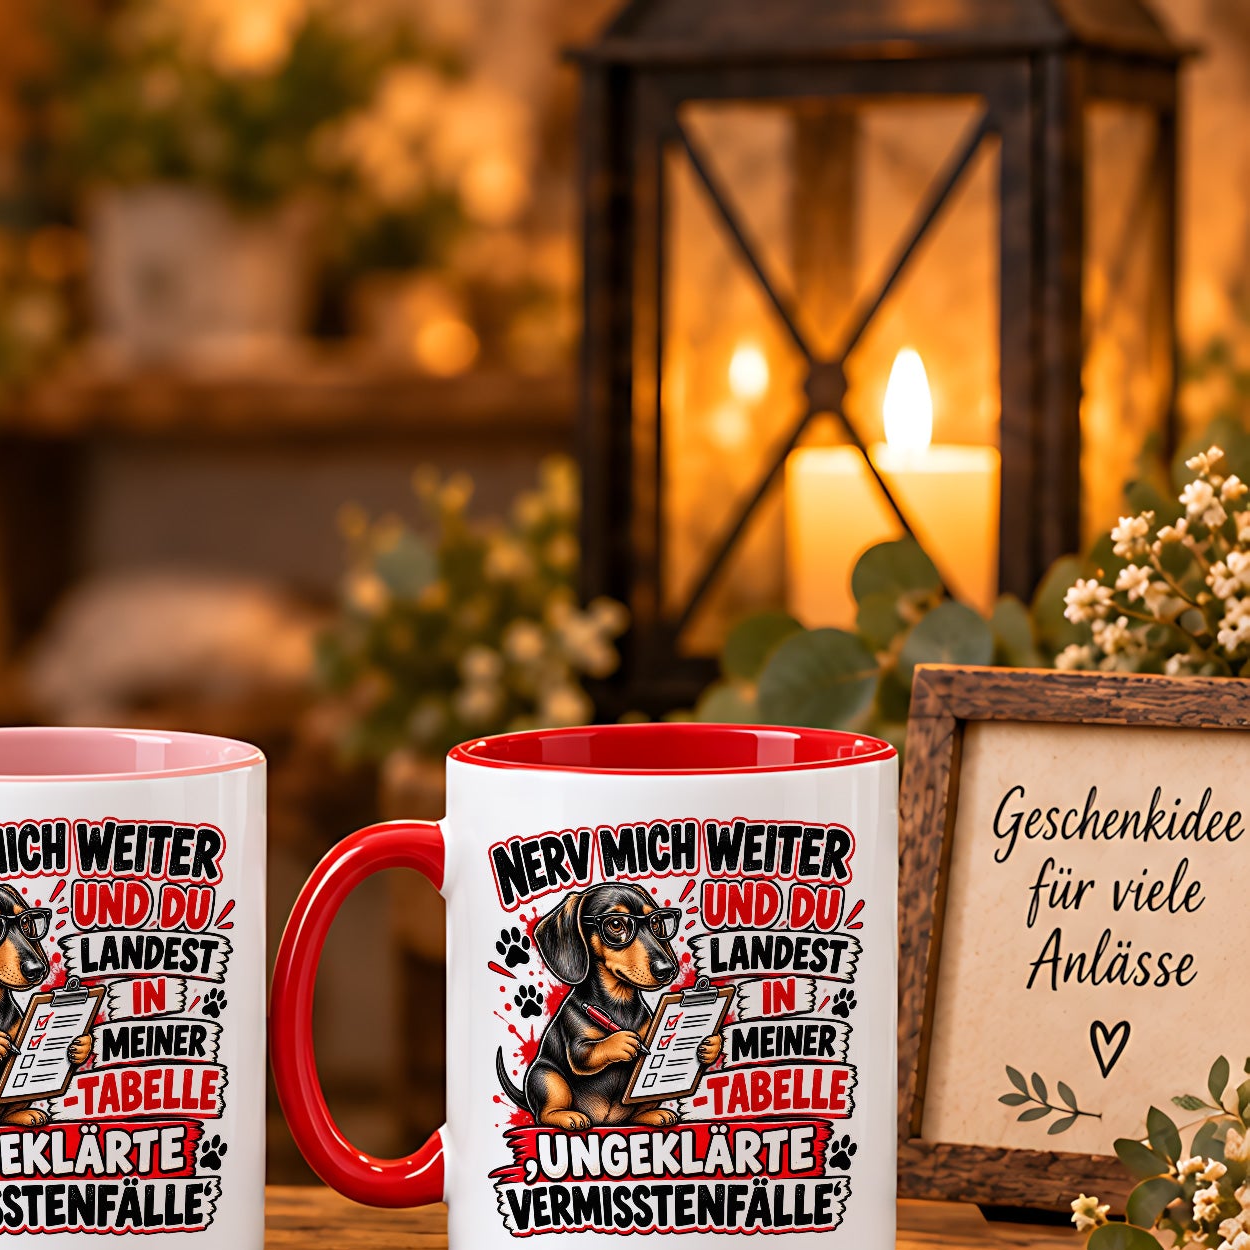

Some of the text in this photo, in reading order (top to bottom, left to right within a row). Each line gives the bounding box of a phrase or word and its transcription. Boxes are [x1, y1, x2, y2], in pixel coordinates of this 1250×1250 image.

[993, 785, 1245, 863] Geschenkidee
[76, 822, 222, 877] WEITER
[493, 822, 852, 904] NERV MICH WEITER
[74, 882, 212, 927] UND DU
[704, 882, 841, 927] UND DU
[1026, 857, 1205, 928] für viele
[81, 937, 219, 972] LANDEST
[711, 937, 849, 972] LANDEST
[1026, 927, 1198, 991] Anlässe
[132, 981, 166, 1014] IN
[762, 981, 795, 1014] IN
[104, 1026, 205, 1059] MEINER
[734, 1026, 835, 1059] MEINER
